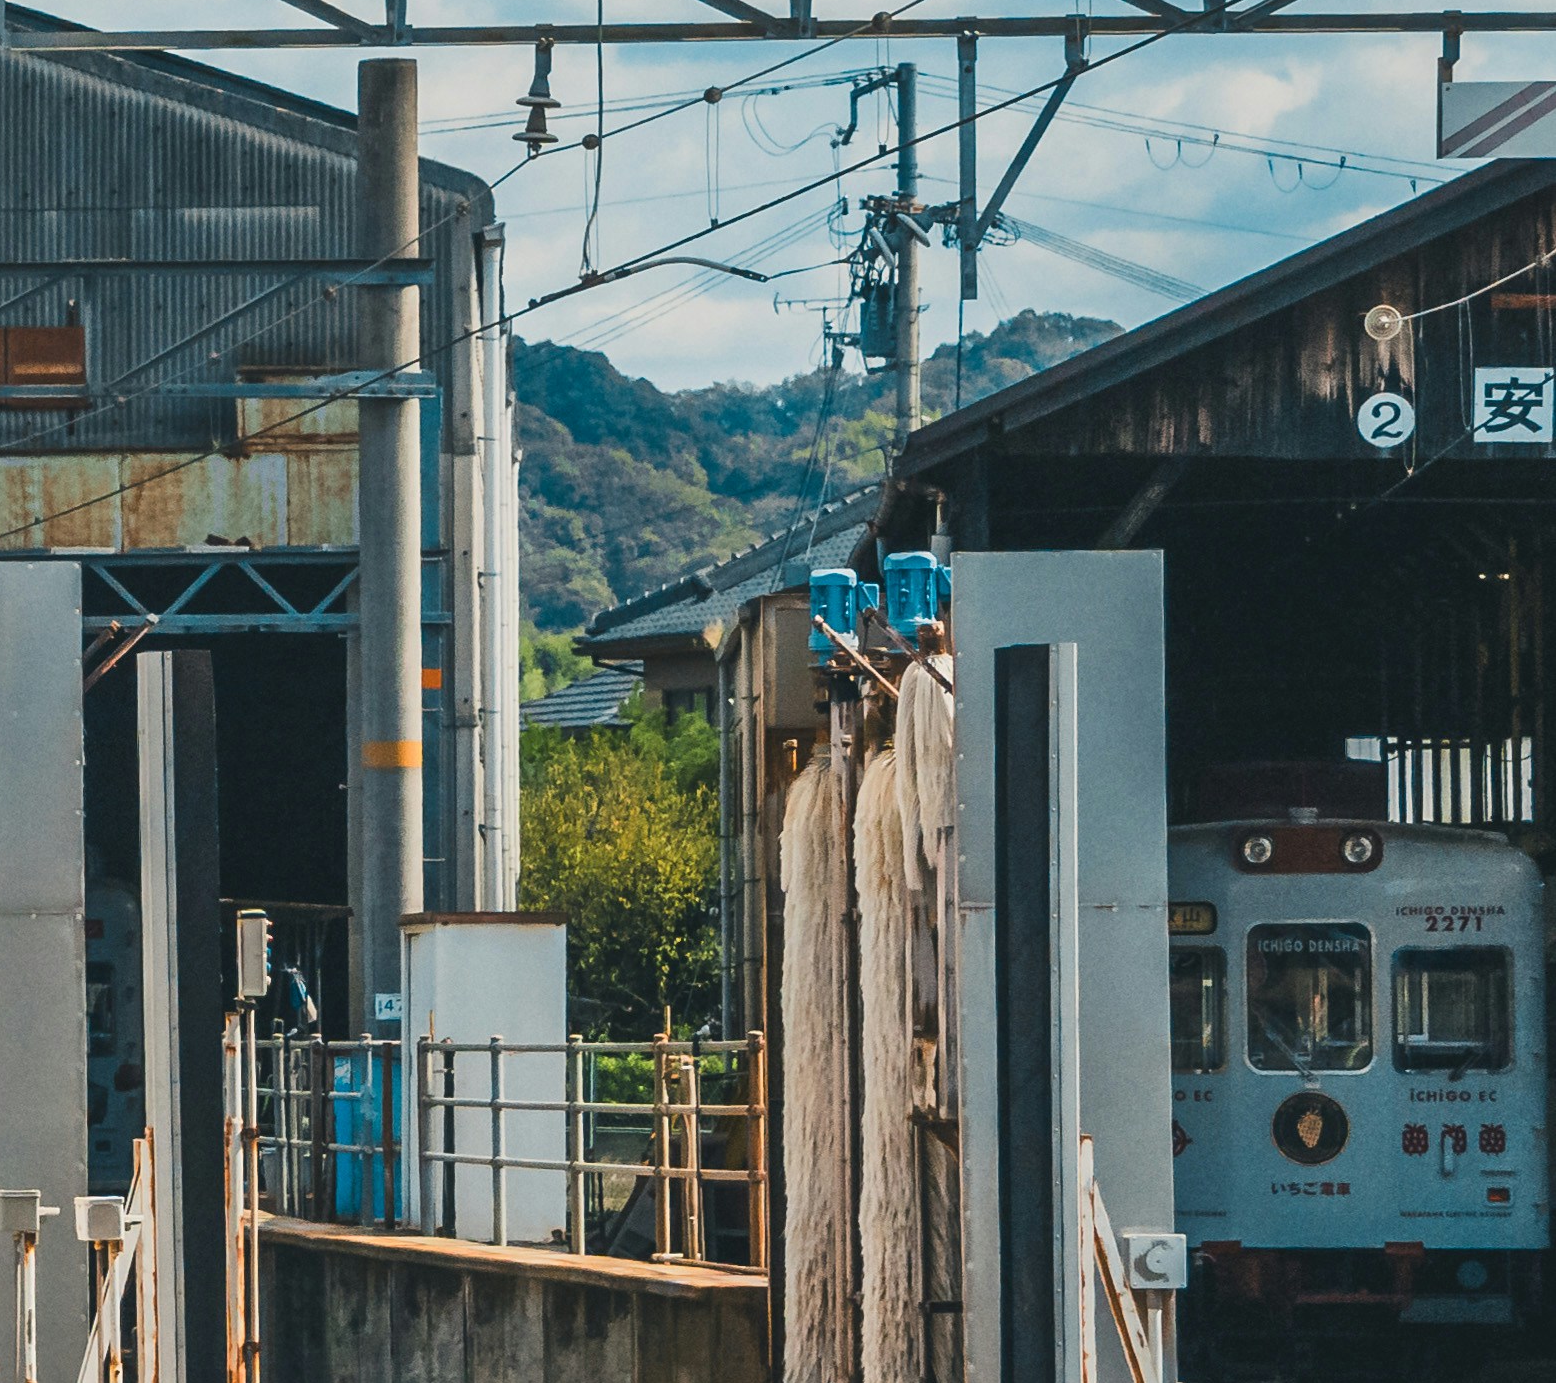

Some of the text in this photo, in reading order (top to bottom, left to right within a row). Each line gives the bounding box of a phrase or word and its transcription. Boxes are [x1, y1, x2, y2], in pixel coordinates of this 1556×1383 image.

[1370, 402, 1404, 439] 2
[1484, 376, 1543, 434] 安
[1425, 916, 1484, 932] 2271
